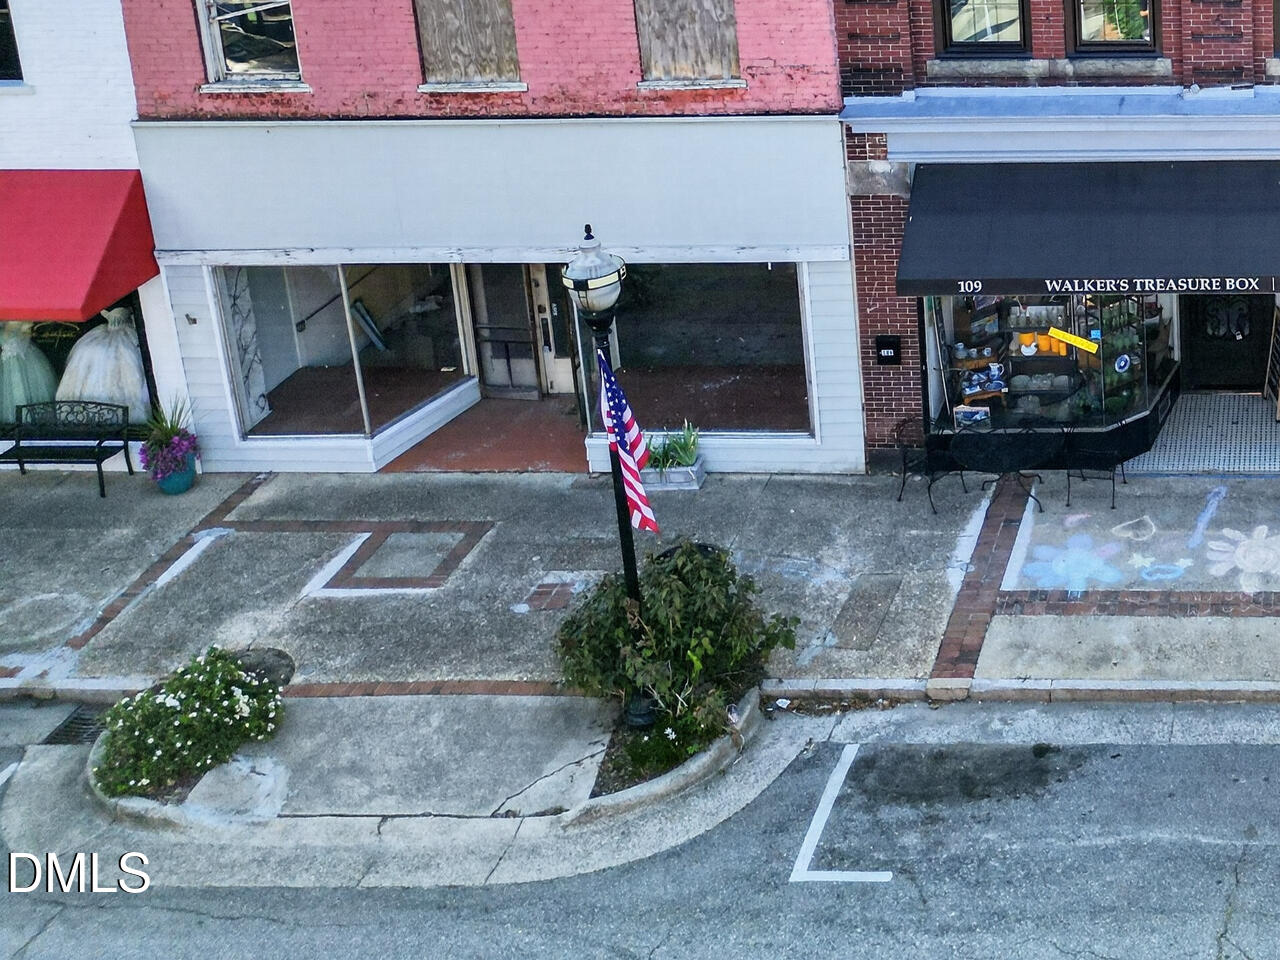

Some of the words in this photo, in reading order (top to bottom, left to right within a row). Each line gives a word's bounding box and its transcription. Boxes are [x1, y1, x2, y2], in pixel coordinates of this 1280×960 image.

[957, 280, 983, 293] 109
[1045, 279, 1129, 292] WALKER'S
[1133, 278, 1223, 291] TREASURE
[1225, 278, 1259, 291] BOX
